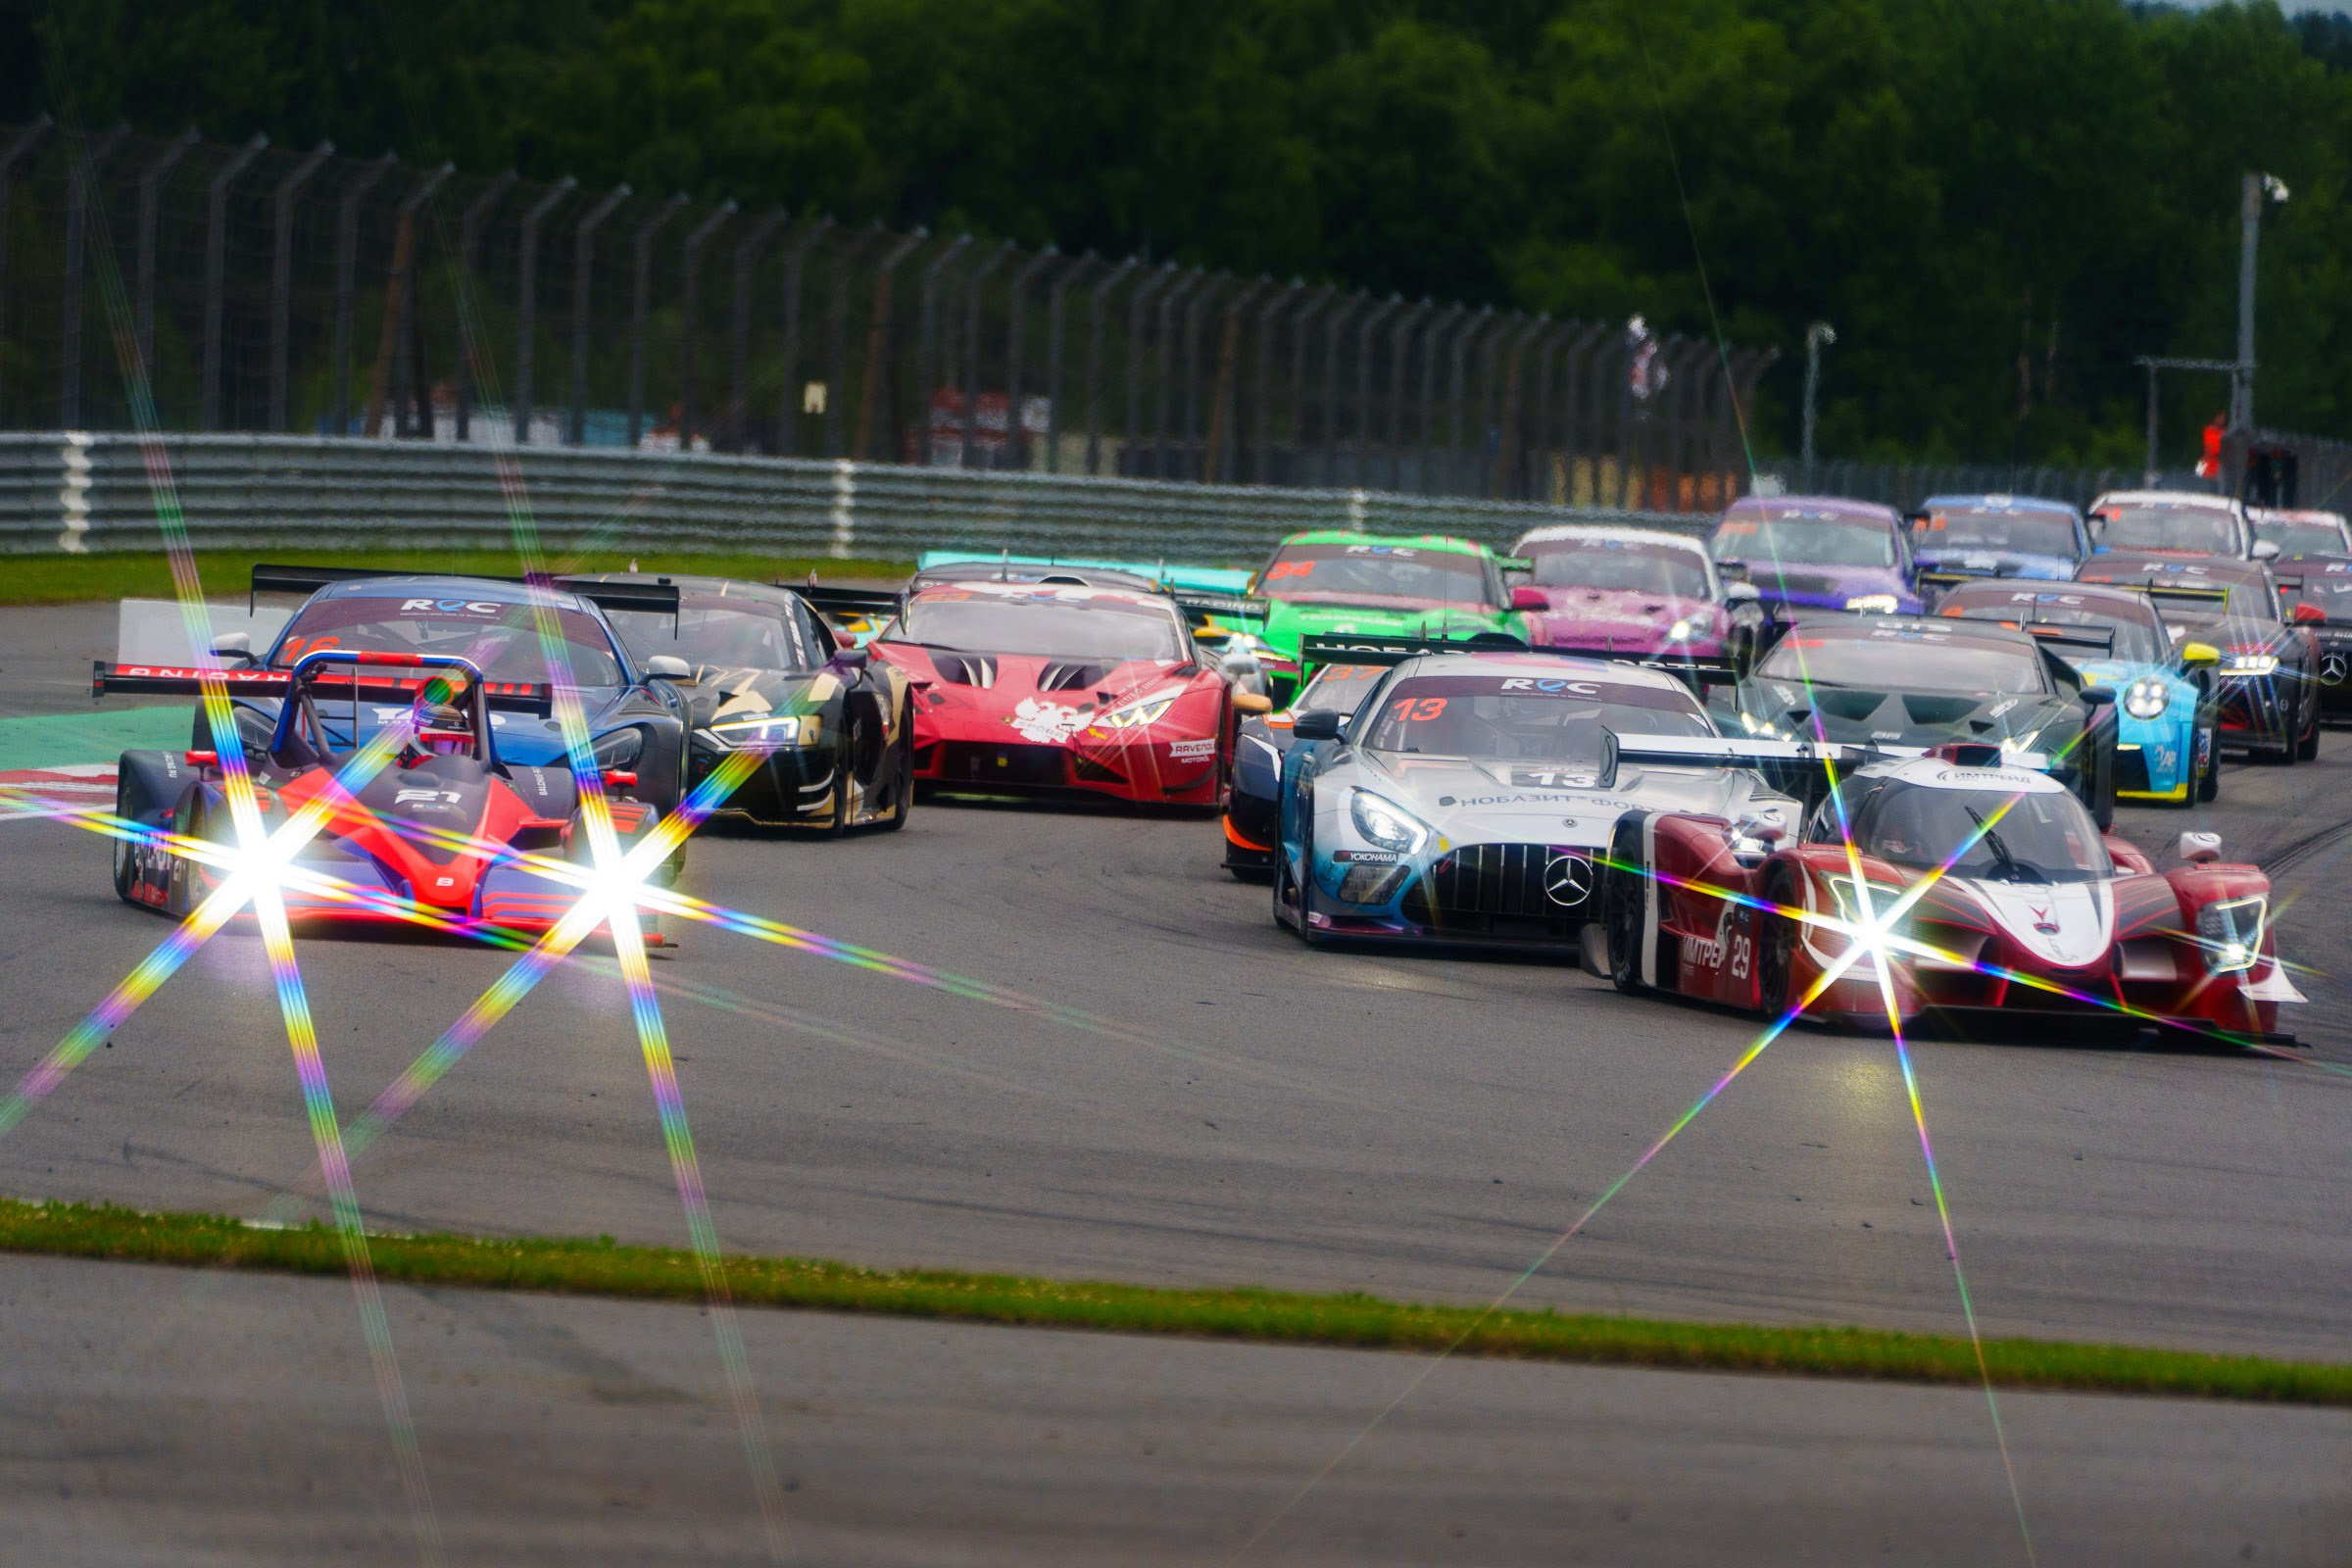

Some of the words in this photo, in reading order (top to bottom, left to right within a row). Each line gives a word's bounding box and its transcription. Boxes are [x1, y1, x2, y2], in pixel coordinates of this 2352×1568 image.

[1393, 698, 1448, 722] 13
[1175, 743, 1214, 754] RAVENOL
[1528, 772, 1597, 788] 13
[1954, 771, 2031, 784] ИМТРЕЙД
[1349, 852, 1397, 862] YOKOHAMA
[1732, 934, 1751, 980] 29
